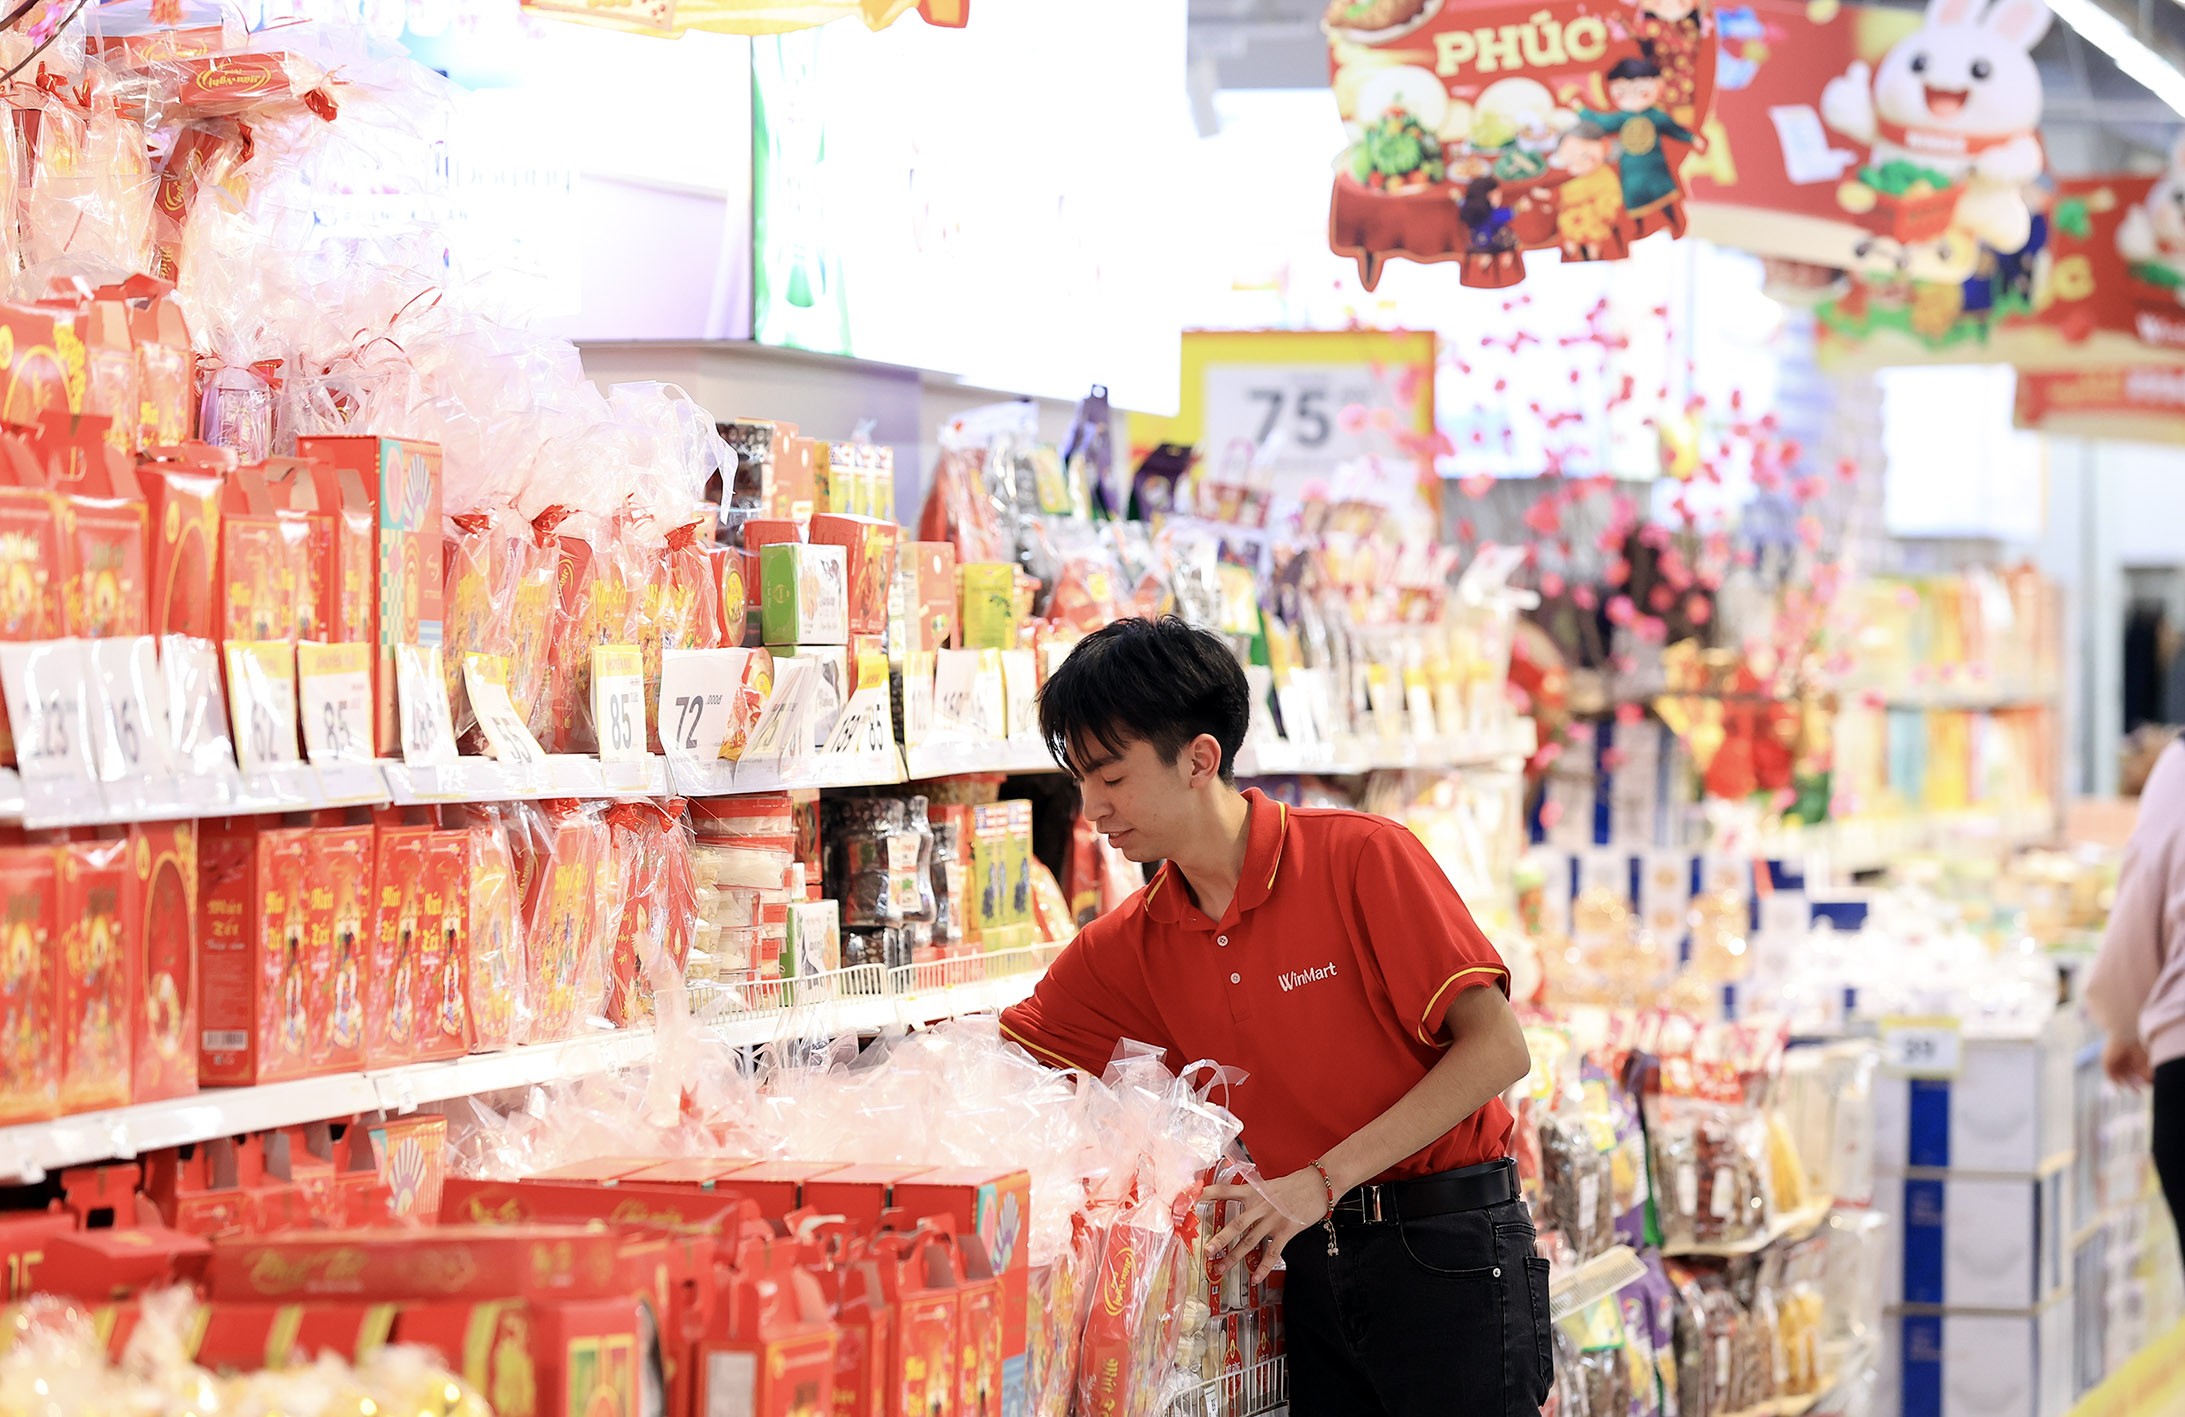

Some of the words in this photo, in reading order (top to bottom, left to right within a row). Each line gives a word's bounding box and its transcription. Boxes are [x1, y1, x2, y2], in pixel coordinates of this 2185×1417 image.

[1433, 10, 1607, 77] PHÚC
[1246, 388, 1332, 448] 75
[610, 694, 632, 750] 85
[676, 695, 704, 749] 72
[1278, 962, 1338, 992] WinMart
